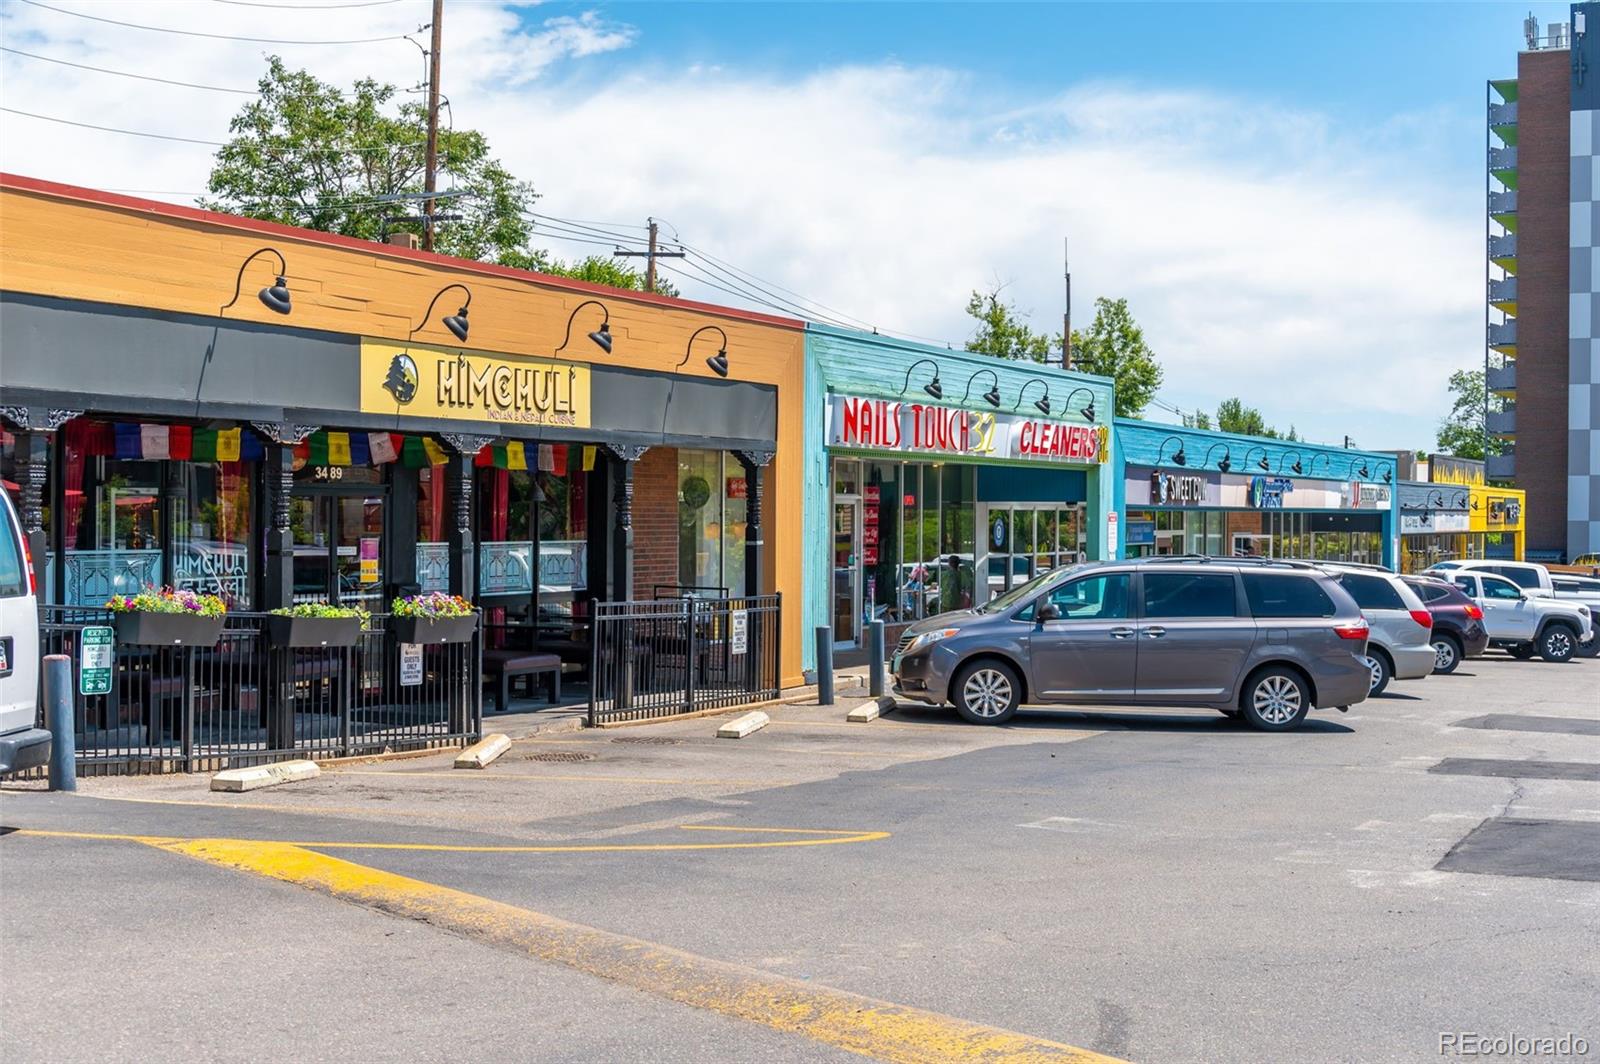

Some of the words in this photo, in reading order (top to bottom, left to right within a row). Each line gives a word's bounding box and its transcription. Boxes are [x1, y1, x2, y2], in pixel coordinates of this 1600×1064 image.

[437, 352, 576, 414] HIMCHULI
[487, 409, 513, 420] INDIAN
[521, 411, 546, 423] NEPALI
[549, 414, 576, 425] CUISINE
[843, 398, 901, 447] NAILS
[911, 404, 969, 451] TOUCH
[1020, 421, 1097, 459] CLEANERS
